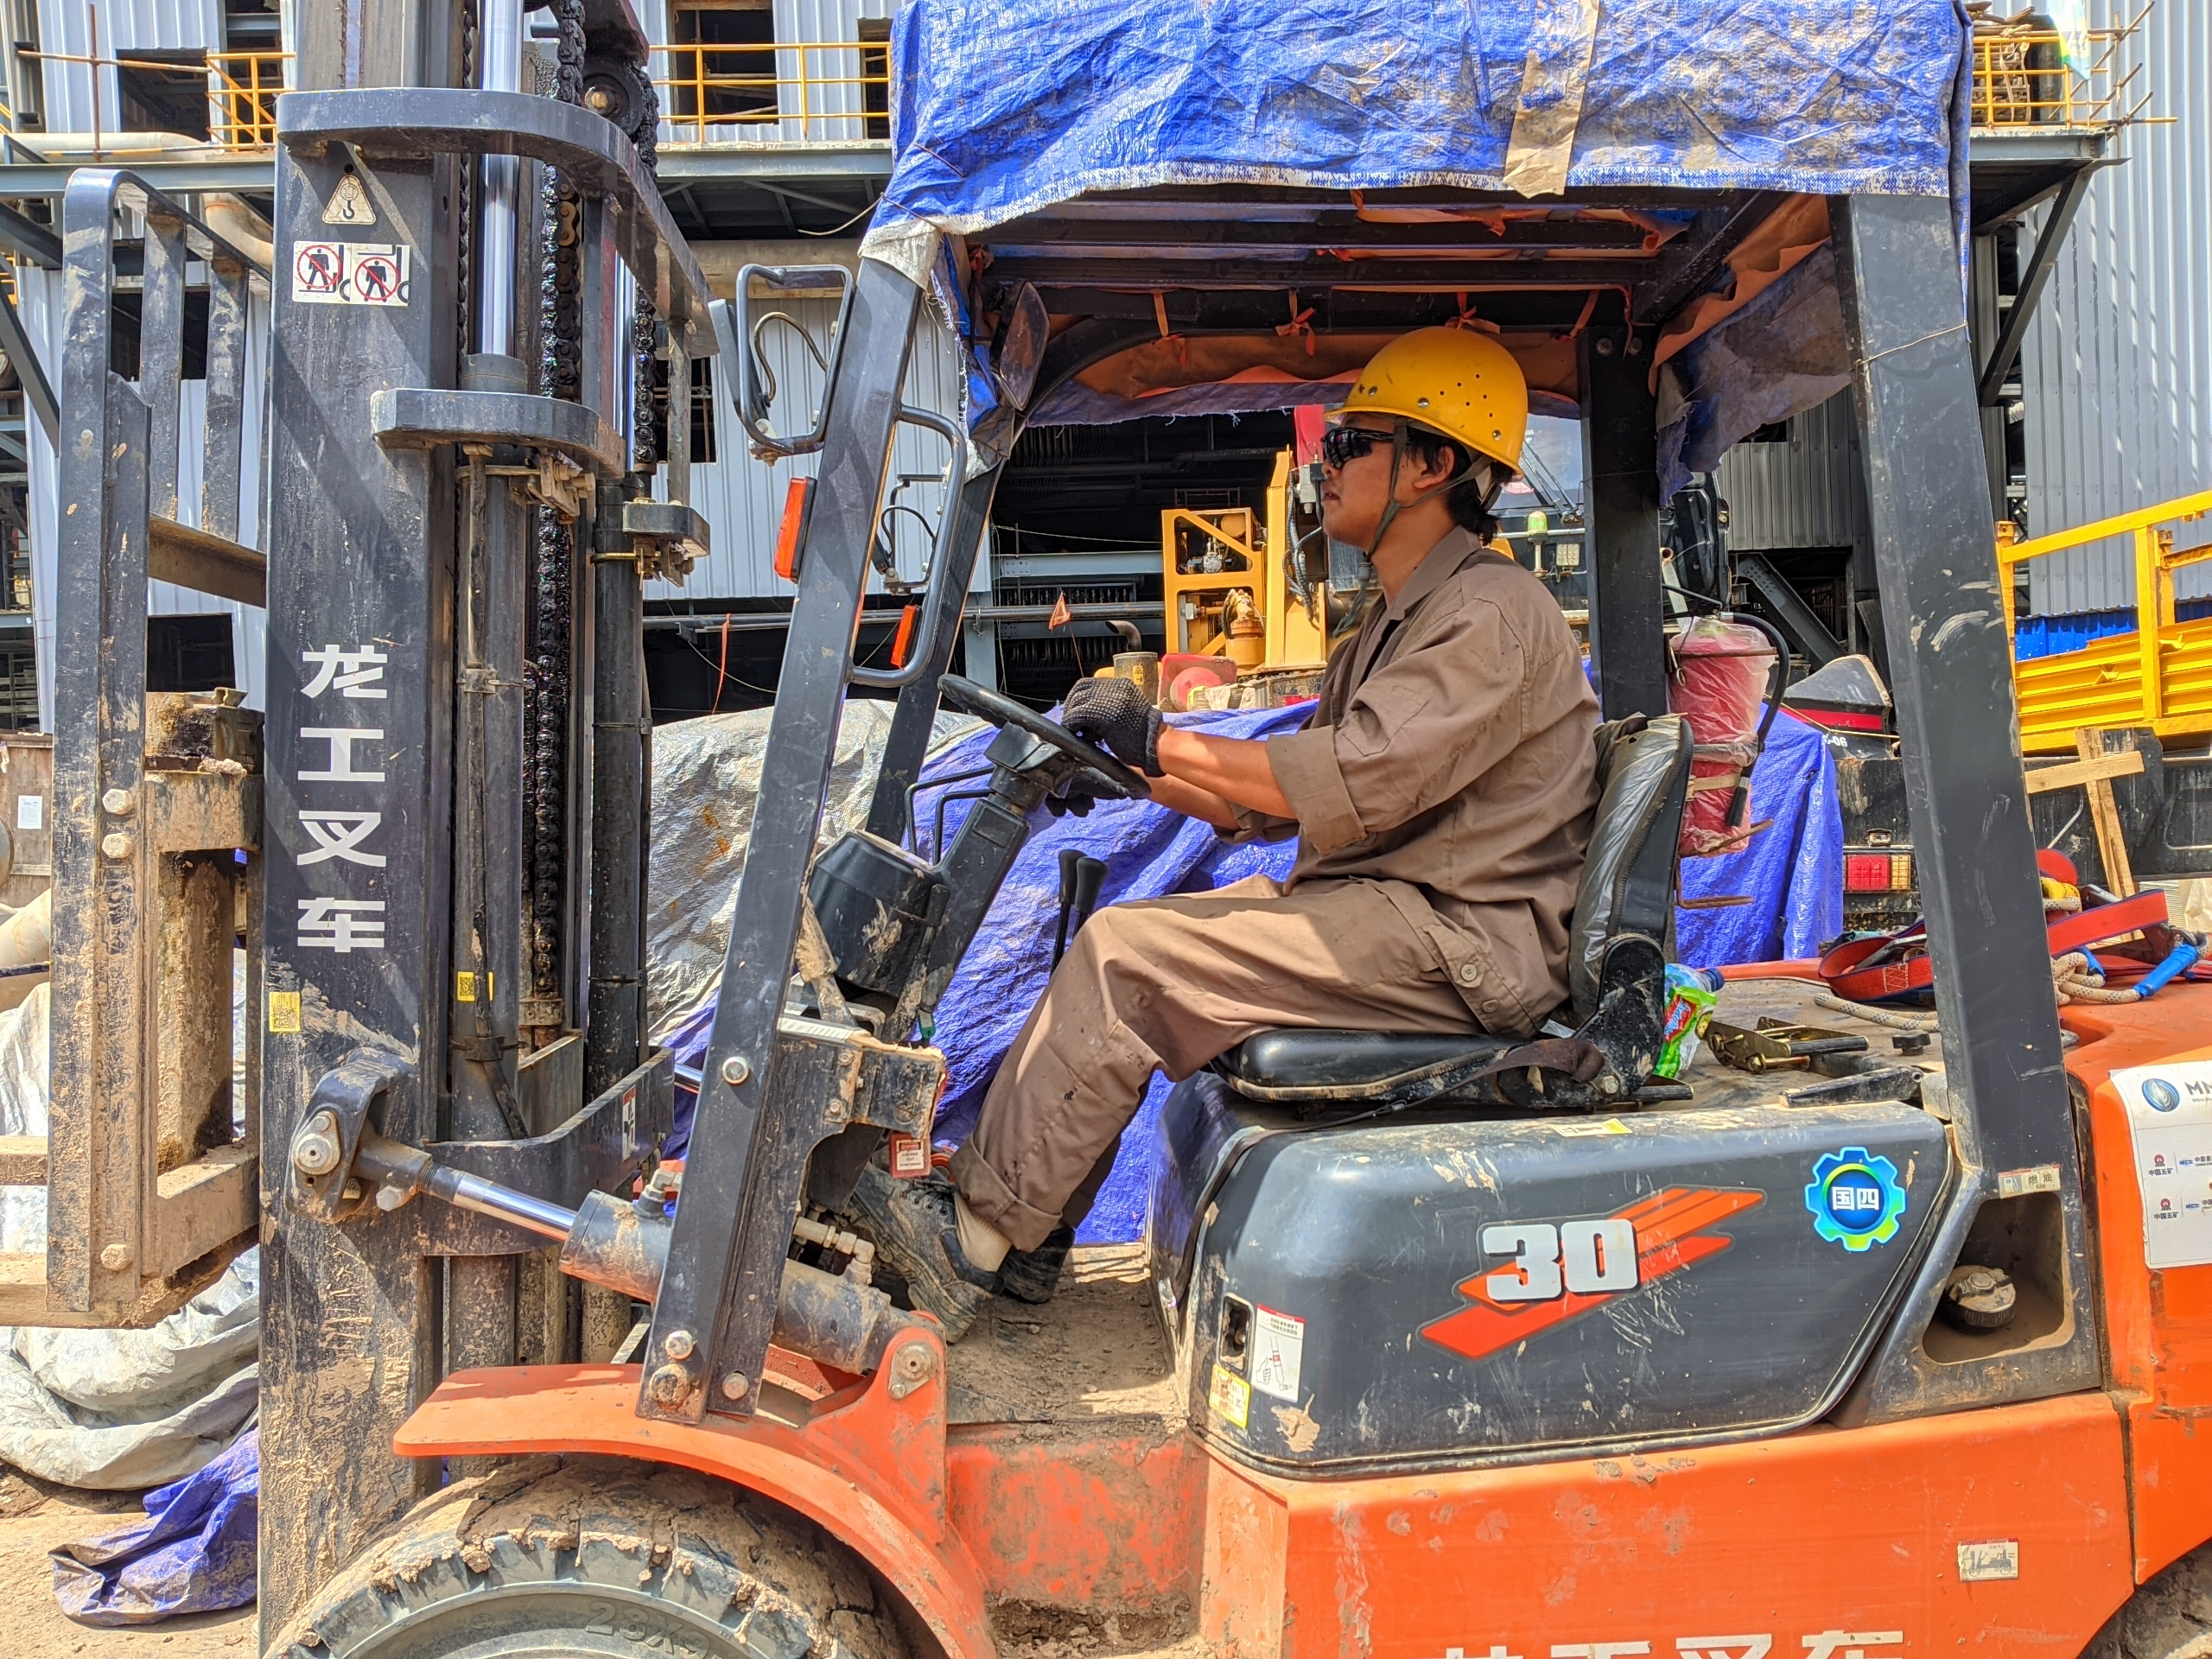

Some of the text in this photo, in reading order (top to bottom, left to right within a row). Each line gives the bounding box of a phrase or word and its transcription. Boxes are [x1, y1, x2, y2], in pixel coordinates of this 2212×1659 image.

[297, 645, 388, 953] 龙工叉车
[2028, 1173, 2052, 1185] 燃油
[1832, 1186, 1879, 1211] 国四
[2154, 1211, 2179, 1220] 中国五矿
[1482, 1218, 1638, 1301] 30
